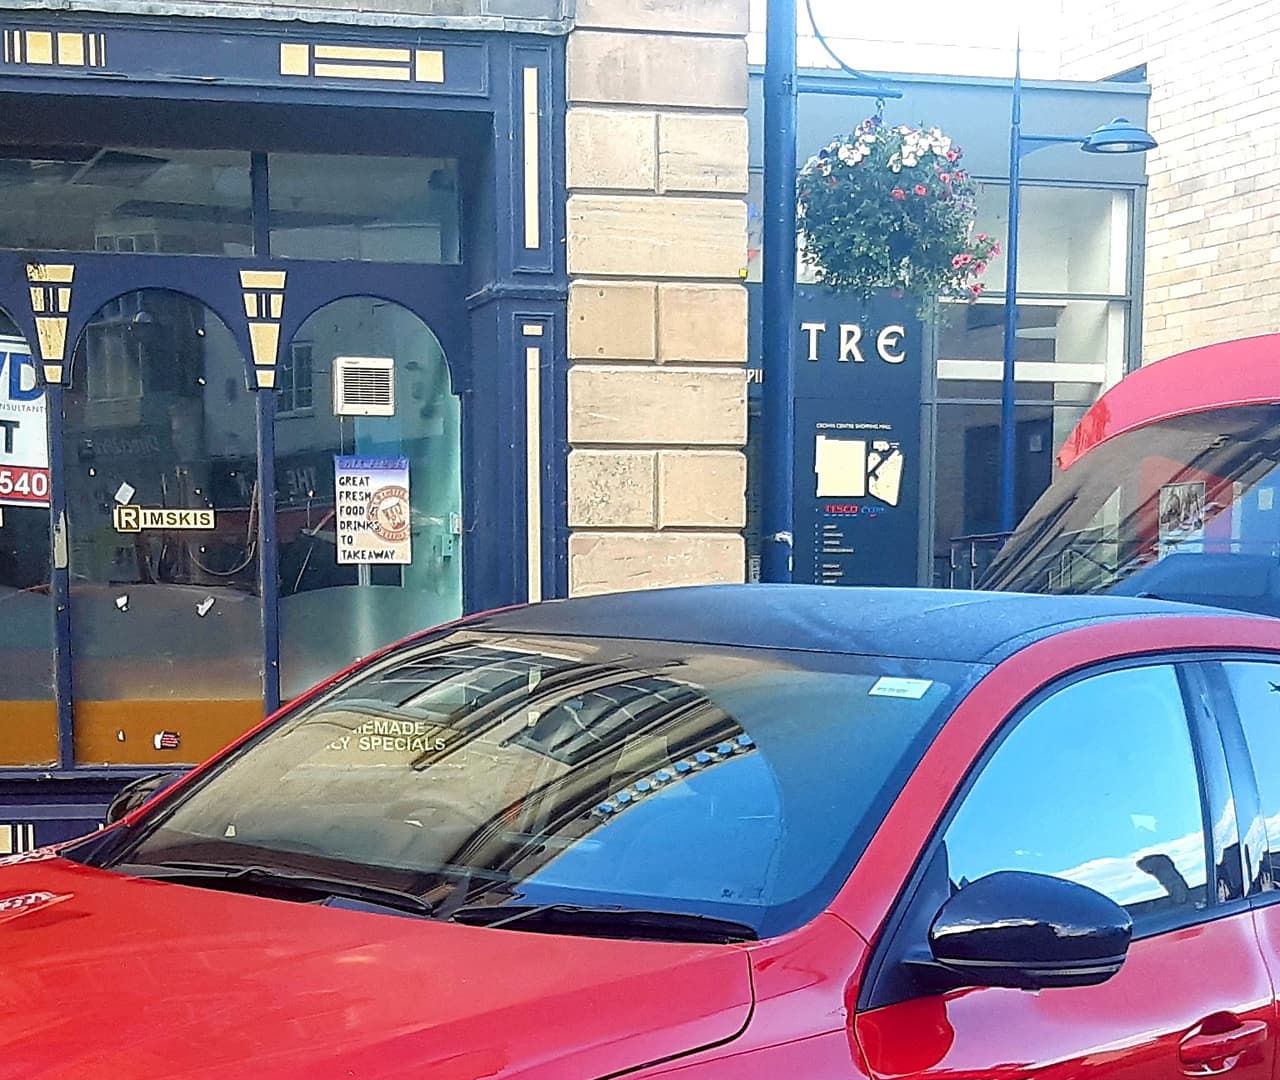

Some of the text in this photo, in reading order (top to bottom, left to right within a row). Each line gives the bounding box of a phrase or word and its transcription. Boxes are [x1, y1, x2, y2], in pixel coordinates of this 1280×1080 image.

[339, 476, 370, 486] GREAT
[339, 491, 371, 501] FRESH
[340, 506, 365, 516] FOOD
[119, 508, 211, 529] RIMSKIS
[340, 521, 381, 531] DRINKS
[341, 535, 354, 545] TO
[341, 550, 396, 561] TAKEAWAY
[358, 736, 447, 751] SPECIALS
